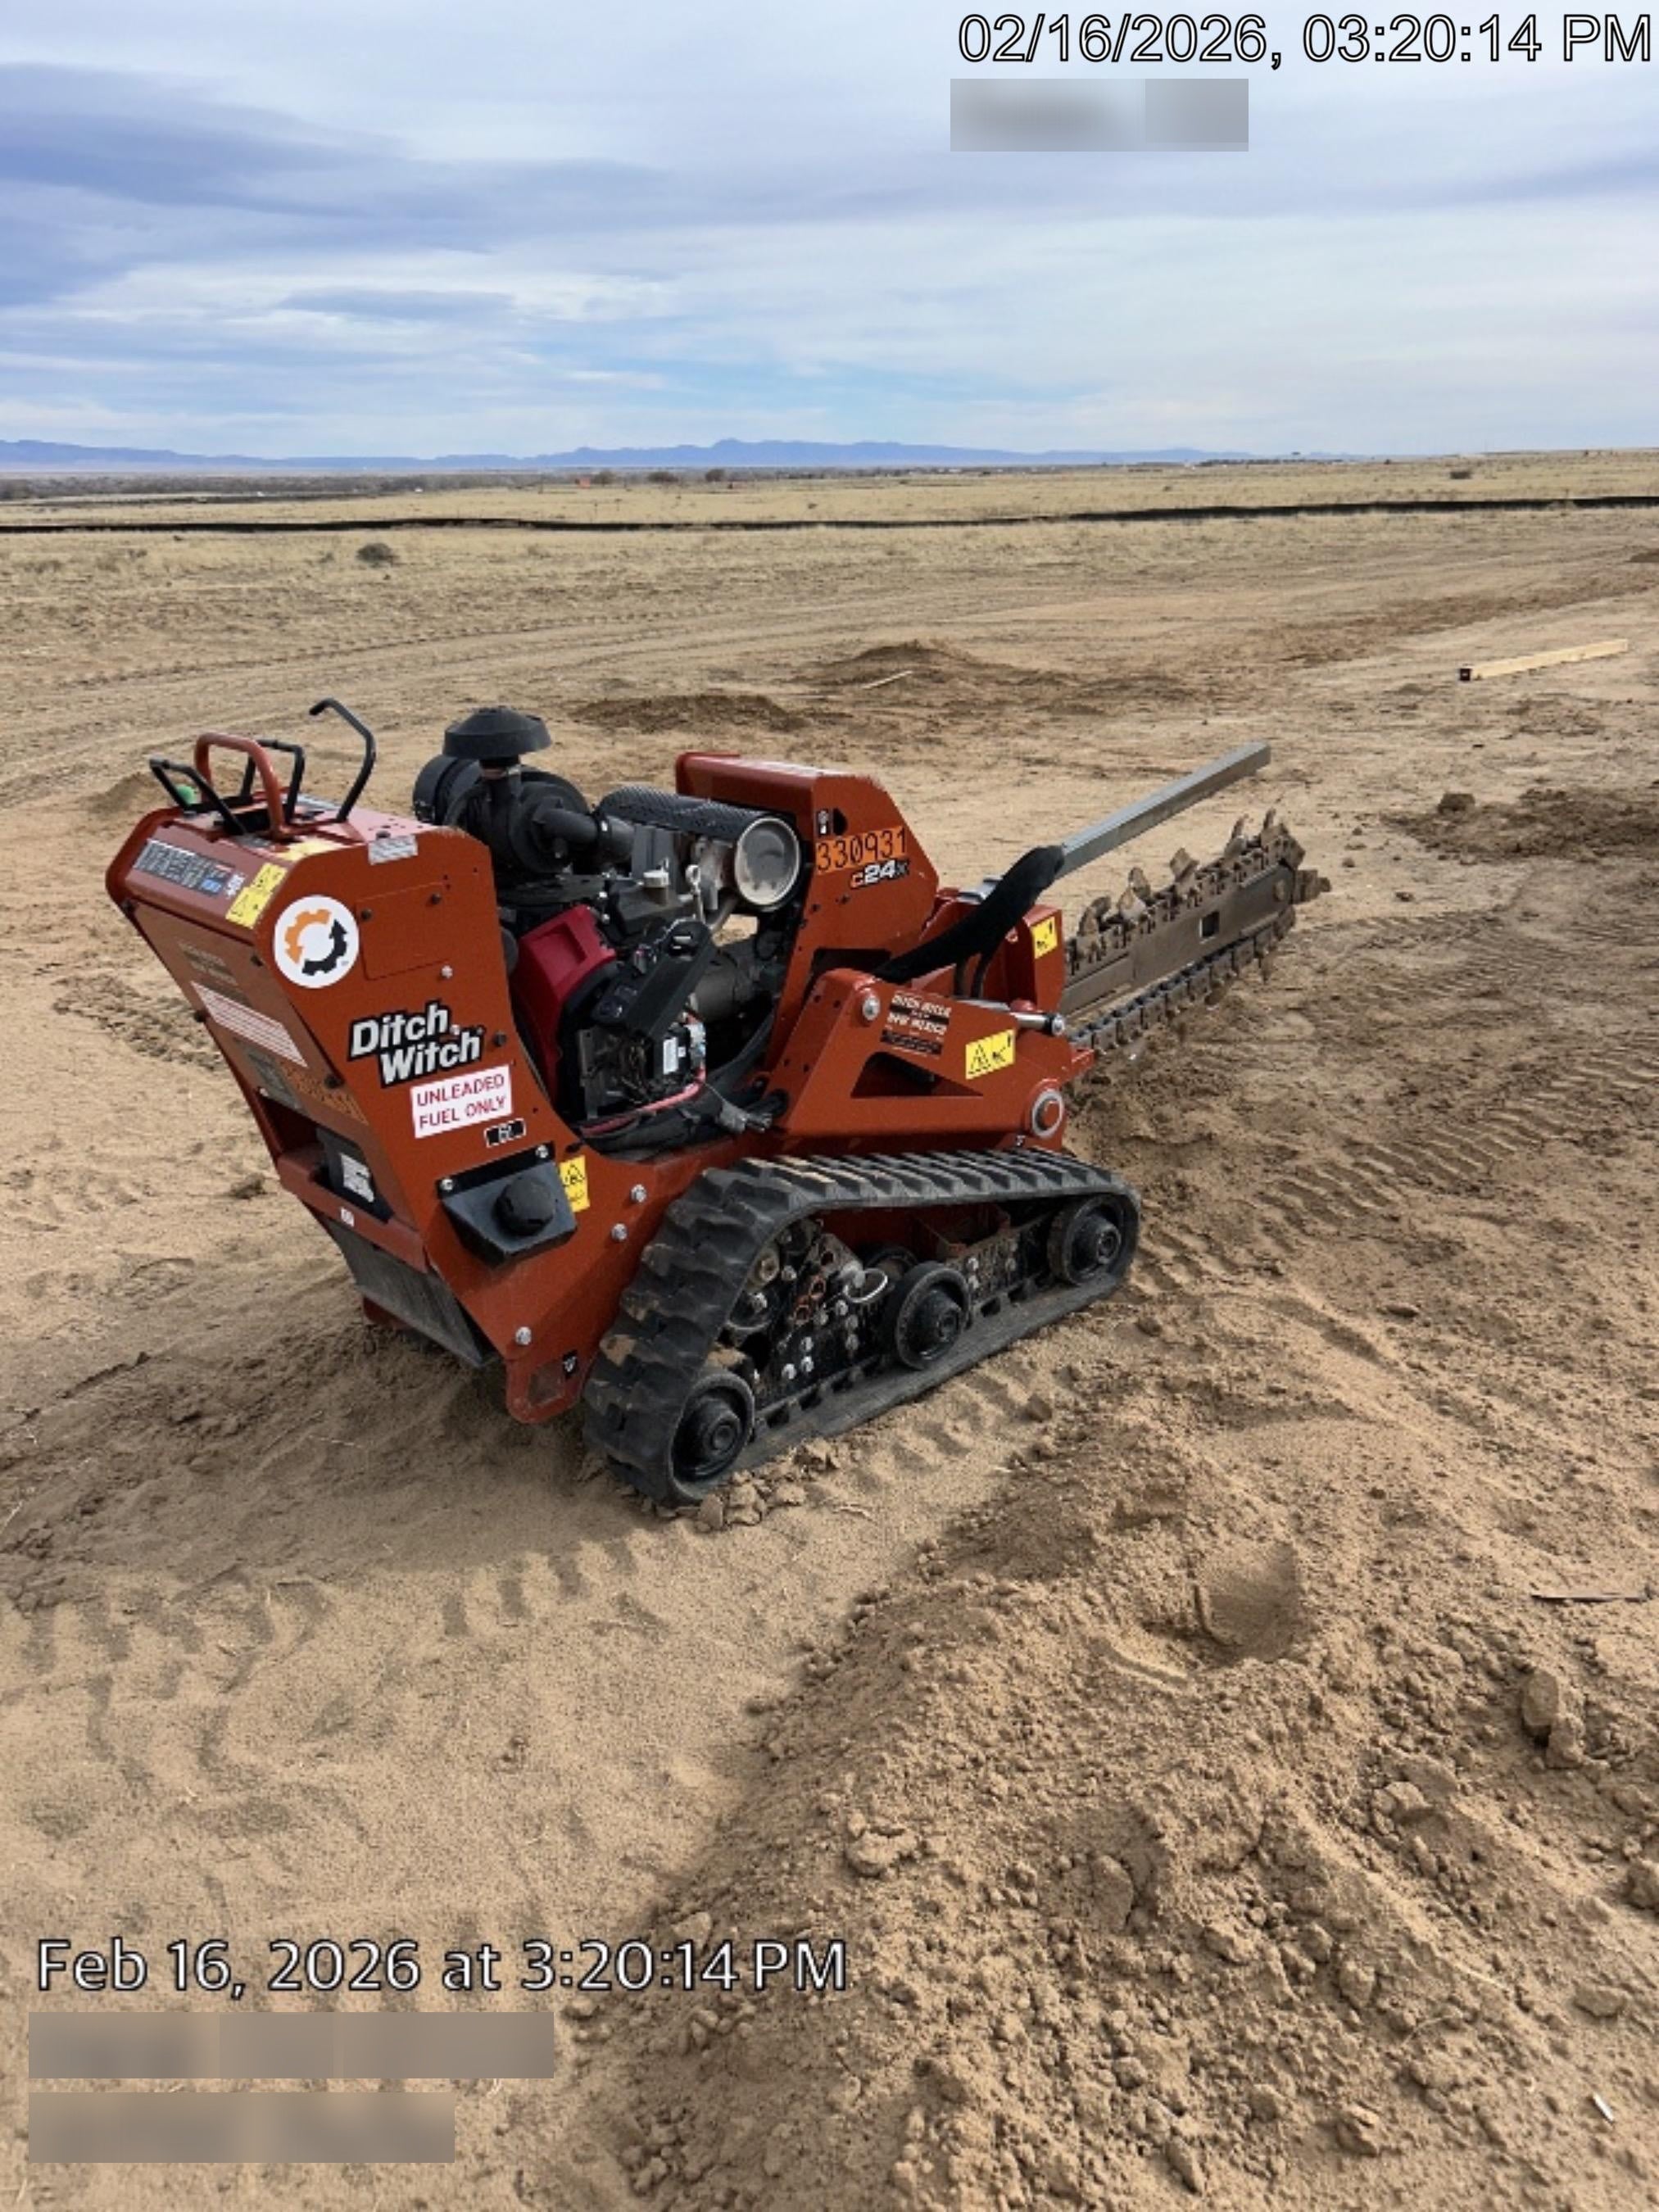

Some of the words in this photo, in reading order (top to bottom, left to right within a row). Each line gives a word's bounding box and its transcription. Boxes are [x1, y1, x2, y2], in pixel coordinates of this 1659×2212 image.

[817, 826, 906, 873] 330931
[350, 1001, 450, 1058] Ditch
[378, 1030, 483, 1086] Witch
[416, 1073, 505, 1107] UNLEADED
[419, 1107, 460, 1131] FUEL
[465, 1095, 506, 1117] ONLY
